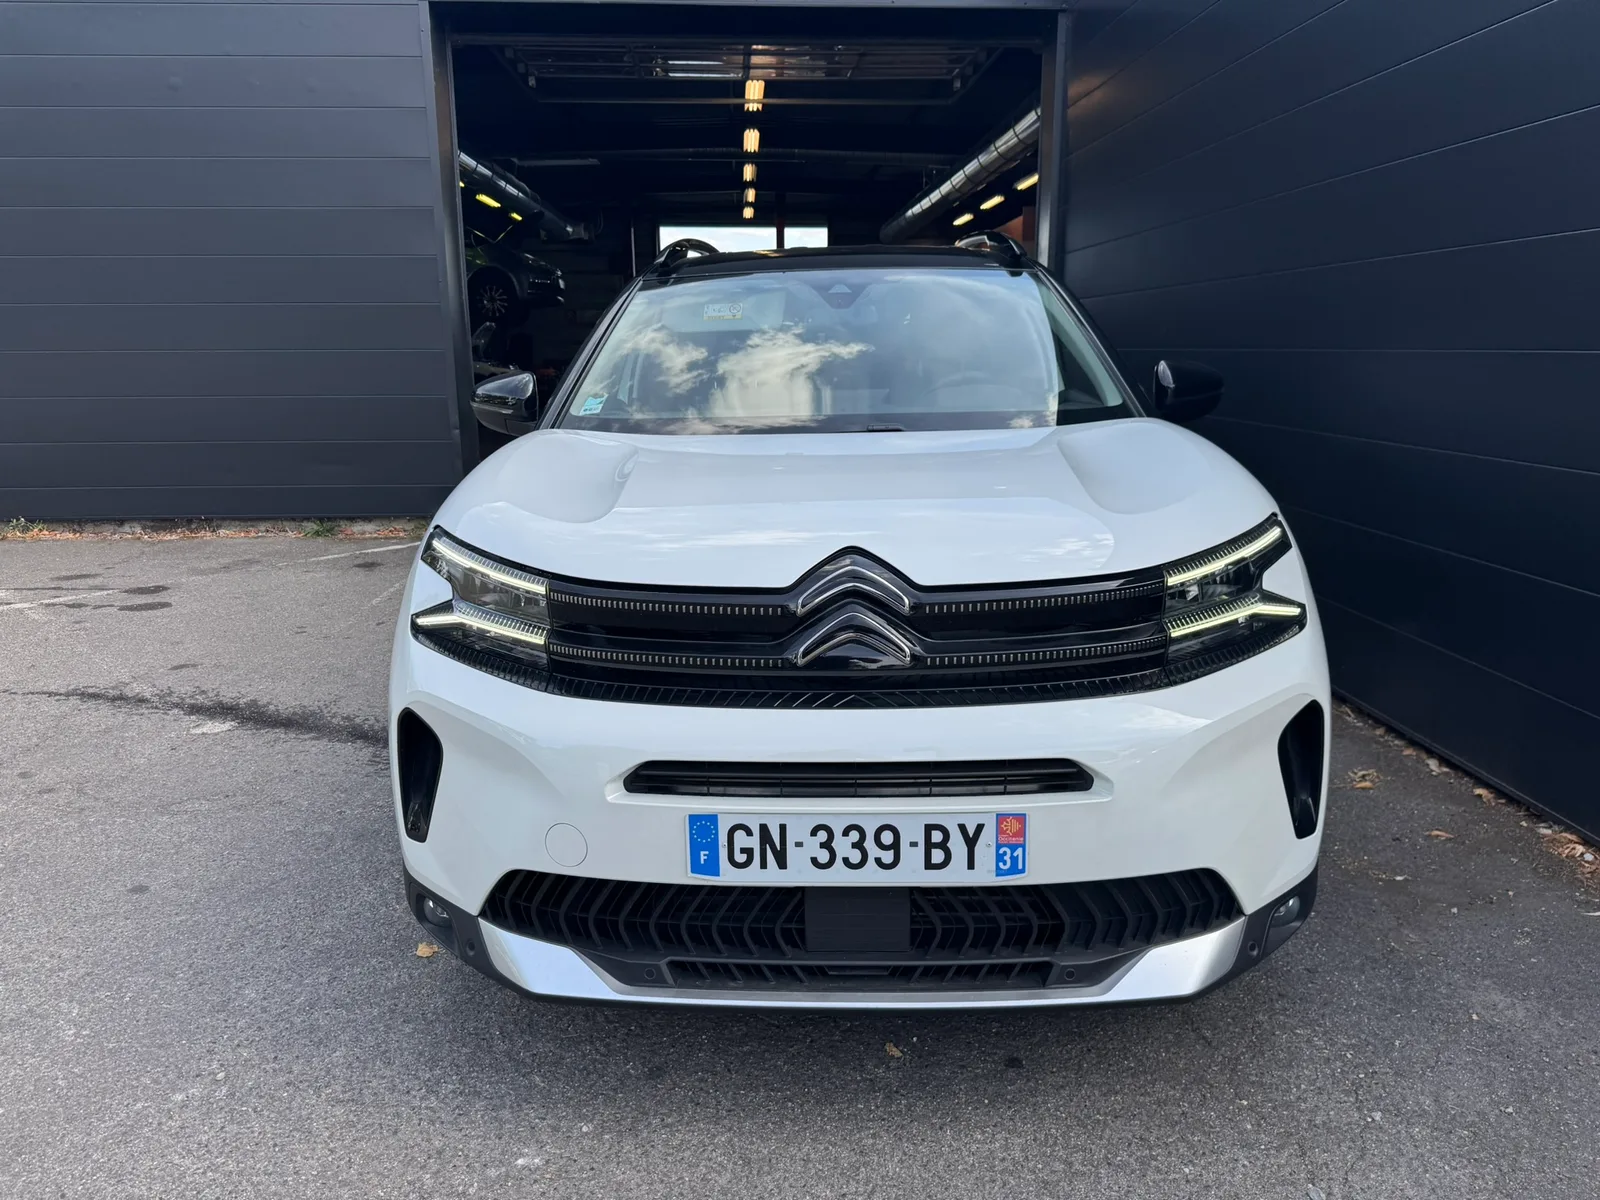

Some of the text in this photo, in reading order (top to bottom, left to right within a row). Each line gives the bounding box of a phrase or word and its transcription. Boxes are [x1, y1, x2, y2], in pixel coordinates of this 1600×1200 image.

[700, 851, 709, 864] F
[727, 823, 985, 870] GN-339-BY
[999, 847, 1023, 870] 31
